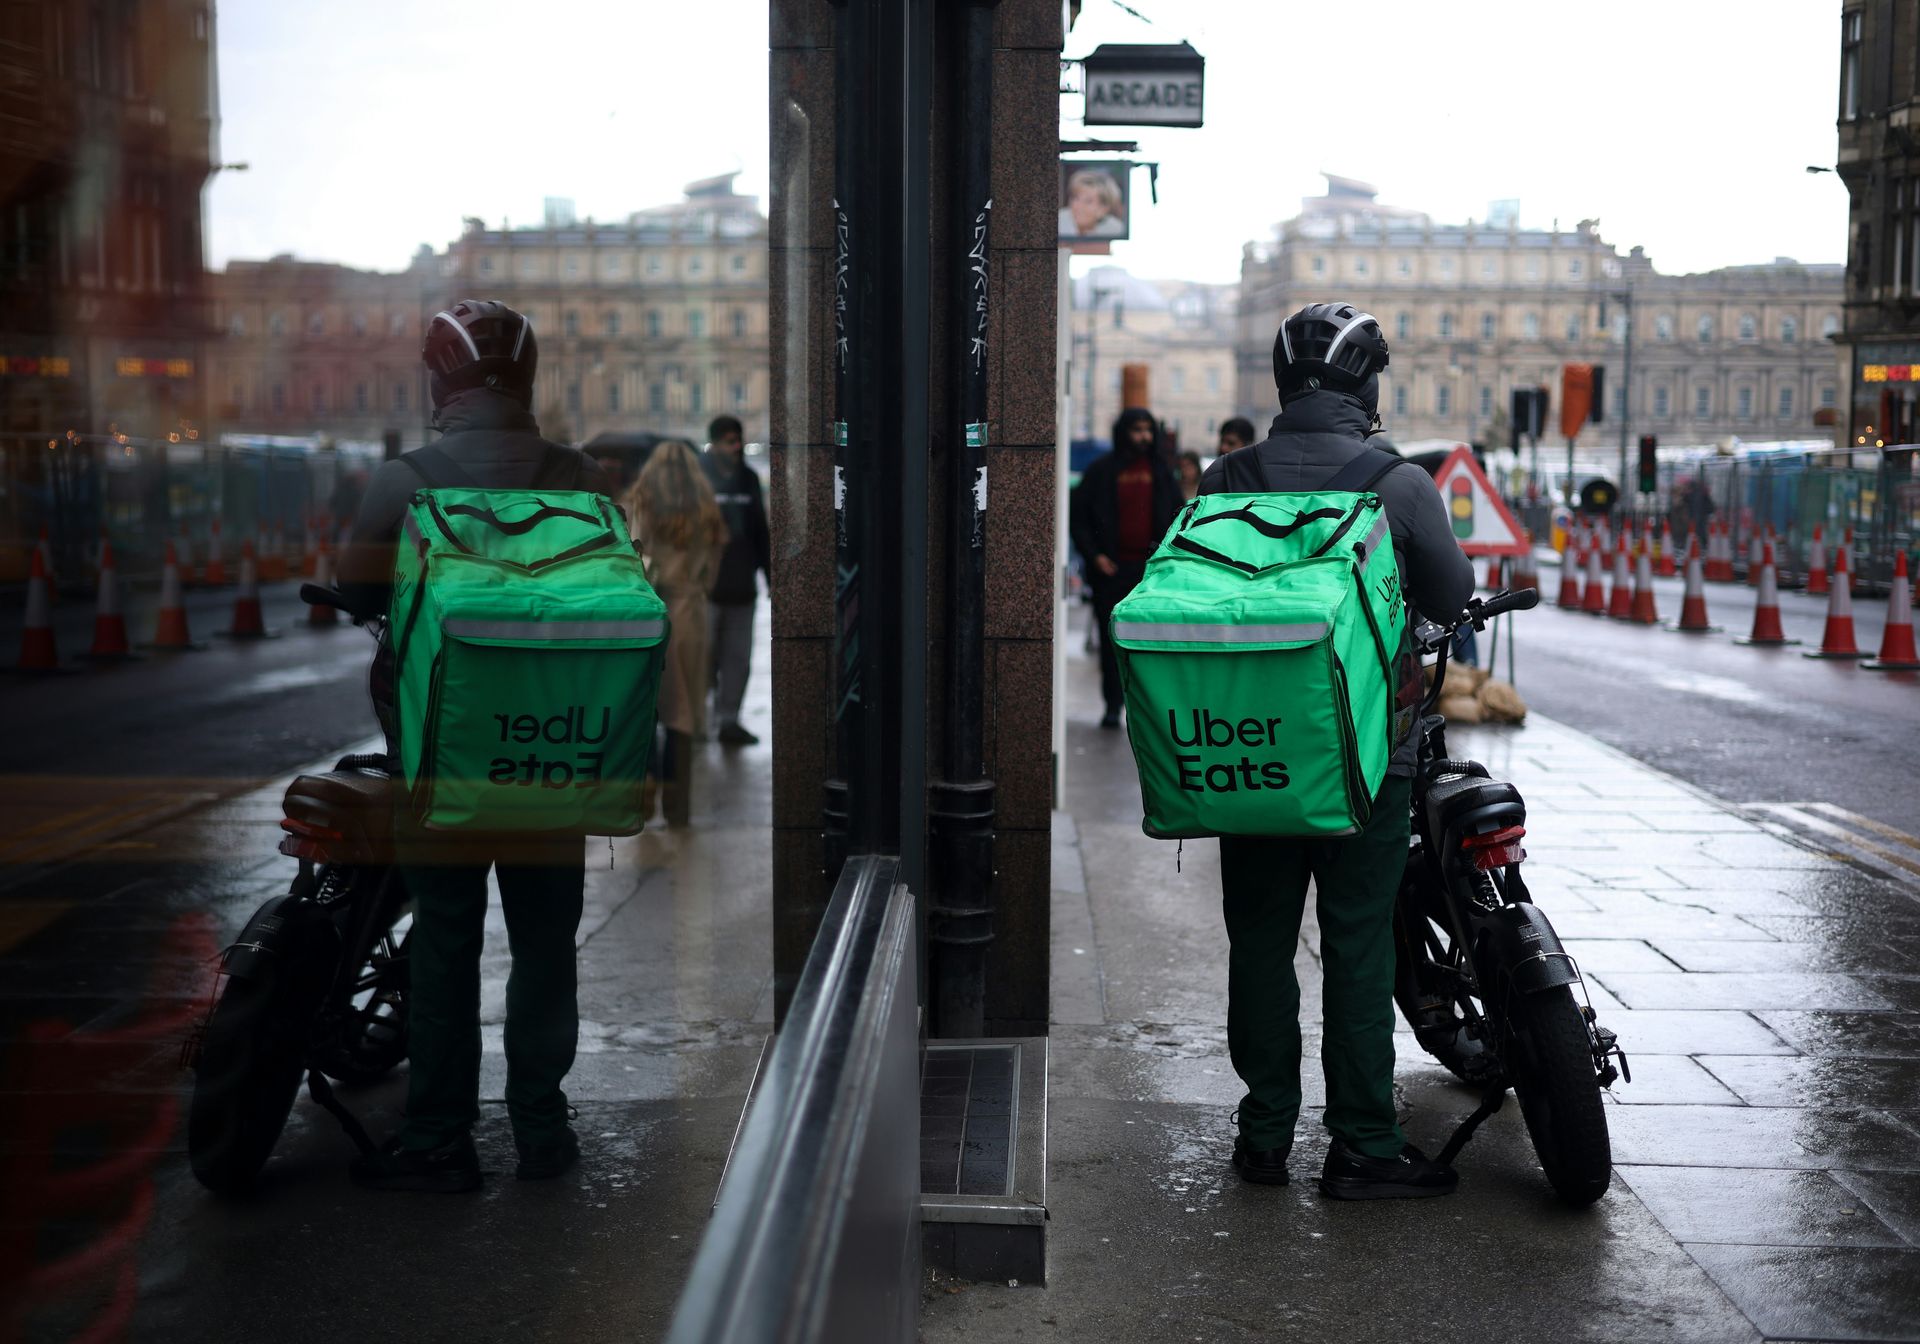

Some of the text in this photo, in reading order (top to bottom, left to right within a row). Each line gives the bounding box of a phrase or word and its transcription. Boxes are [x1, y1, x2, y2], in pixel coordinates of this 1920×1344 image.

[1091, 82, 1200, 107] ARCADE
[1168, 708, 1282, 748] Uber
[1175, 754, 1291, 793] Eats
